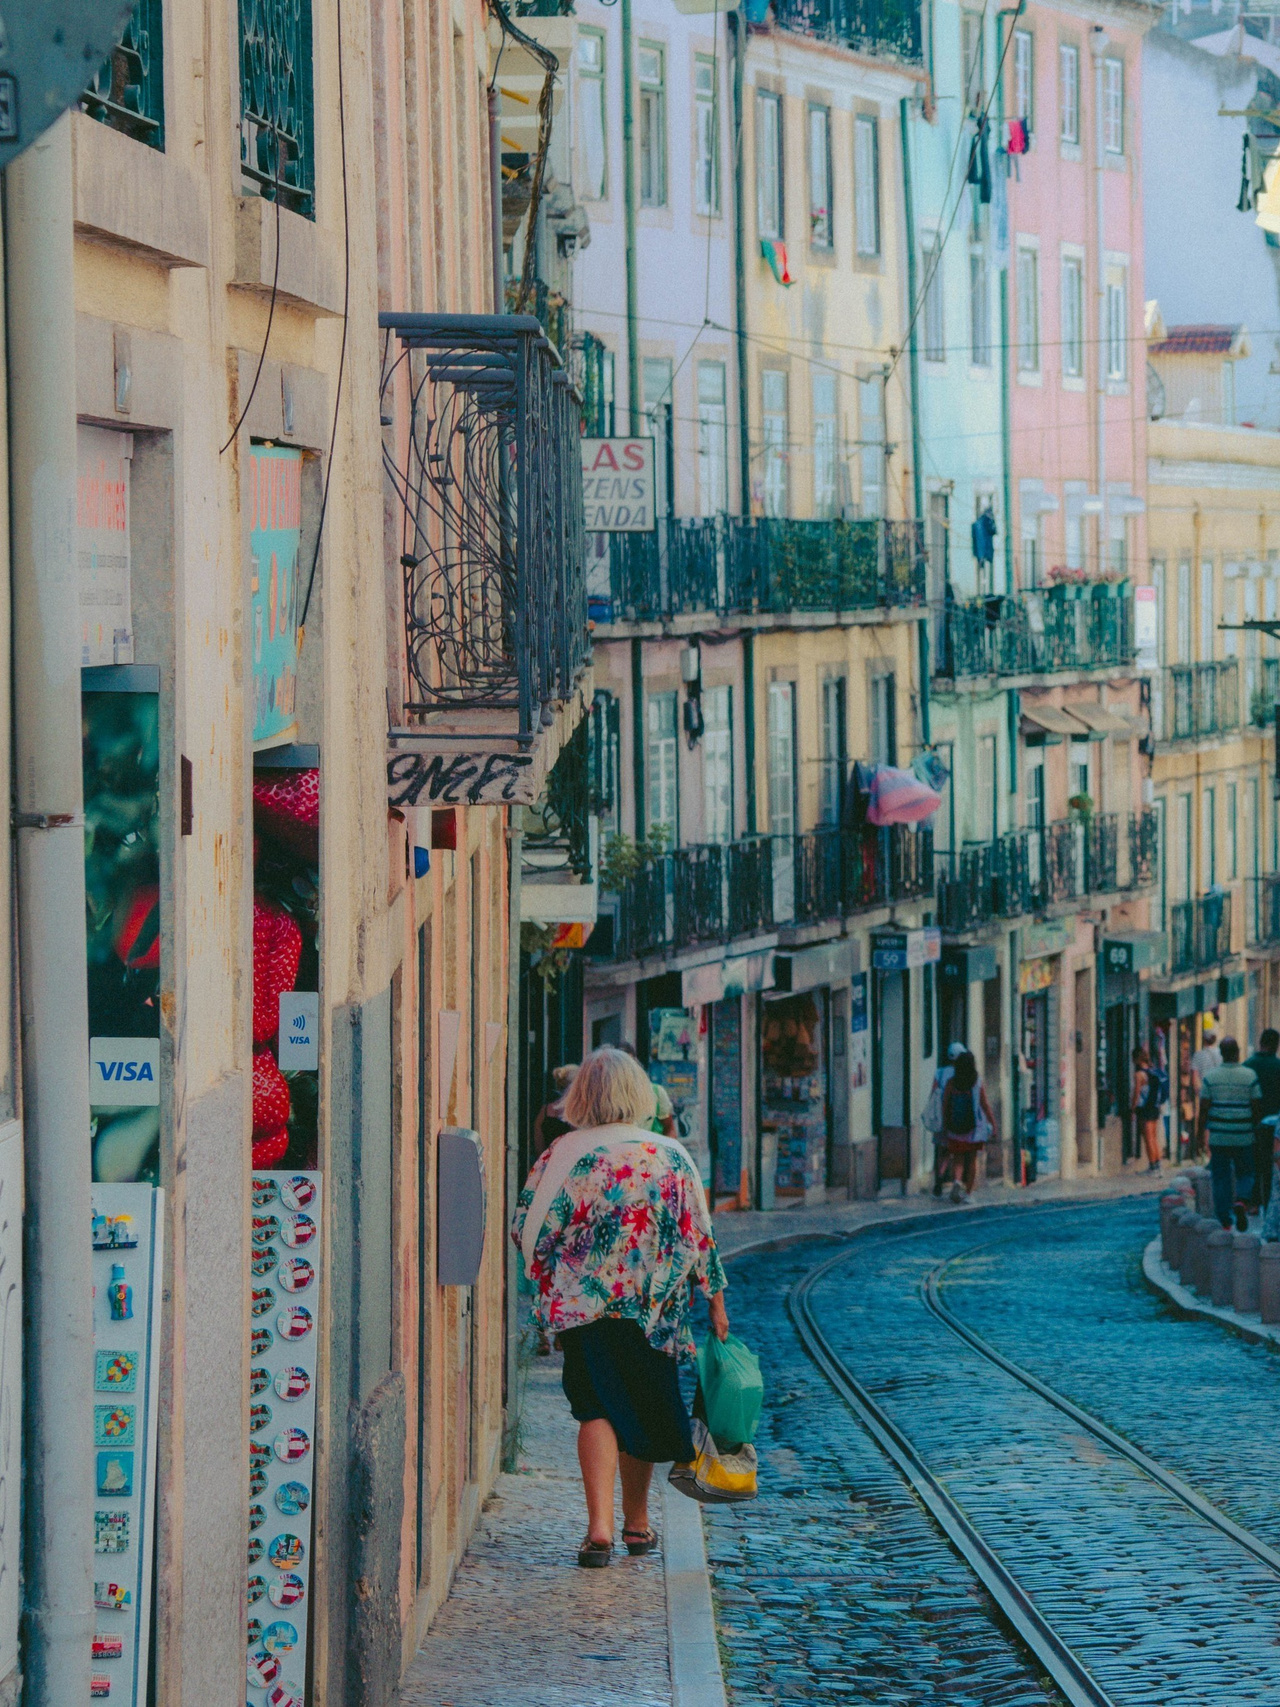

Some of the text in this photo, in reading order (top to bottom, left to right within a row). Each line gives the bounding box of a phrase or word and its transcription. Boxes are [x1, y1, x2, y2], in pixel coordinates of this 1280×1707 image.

[582, 443, 645, 471] AS
[883, 954, 899, 965] 59
[1110, 948, 1127, 964] 69
[288, 1036, 310, 1045] VISA
[95, 1061, 154, 1081] VISA
